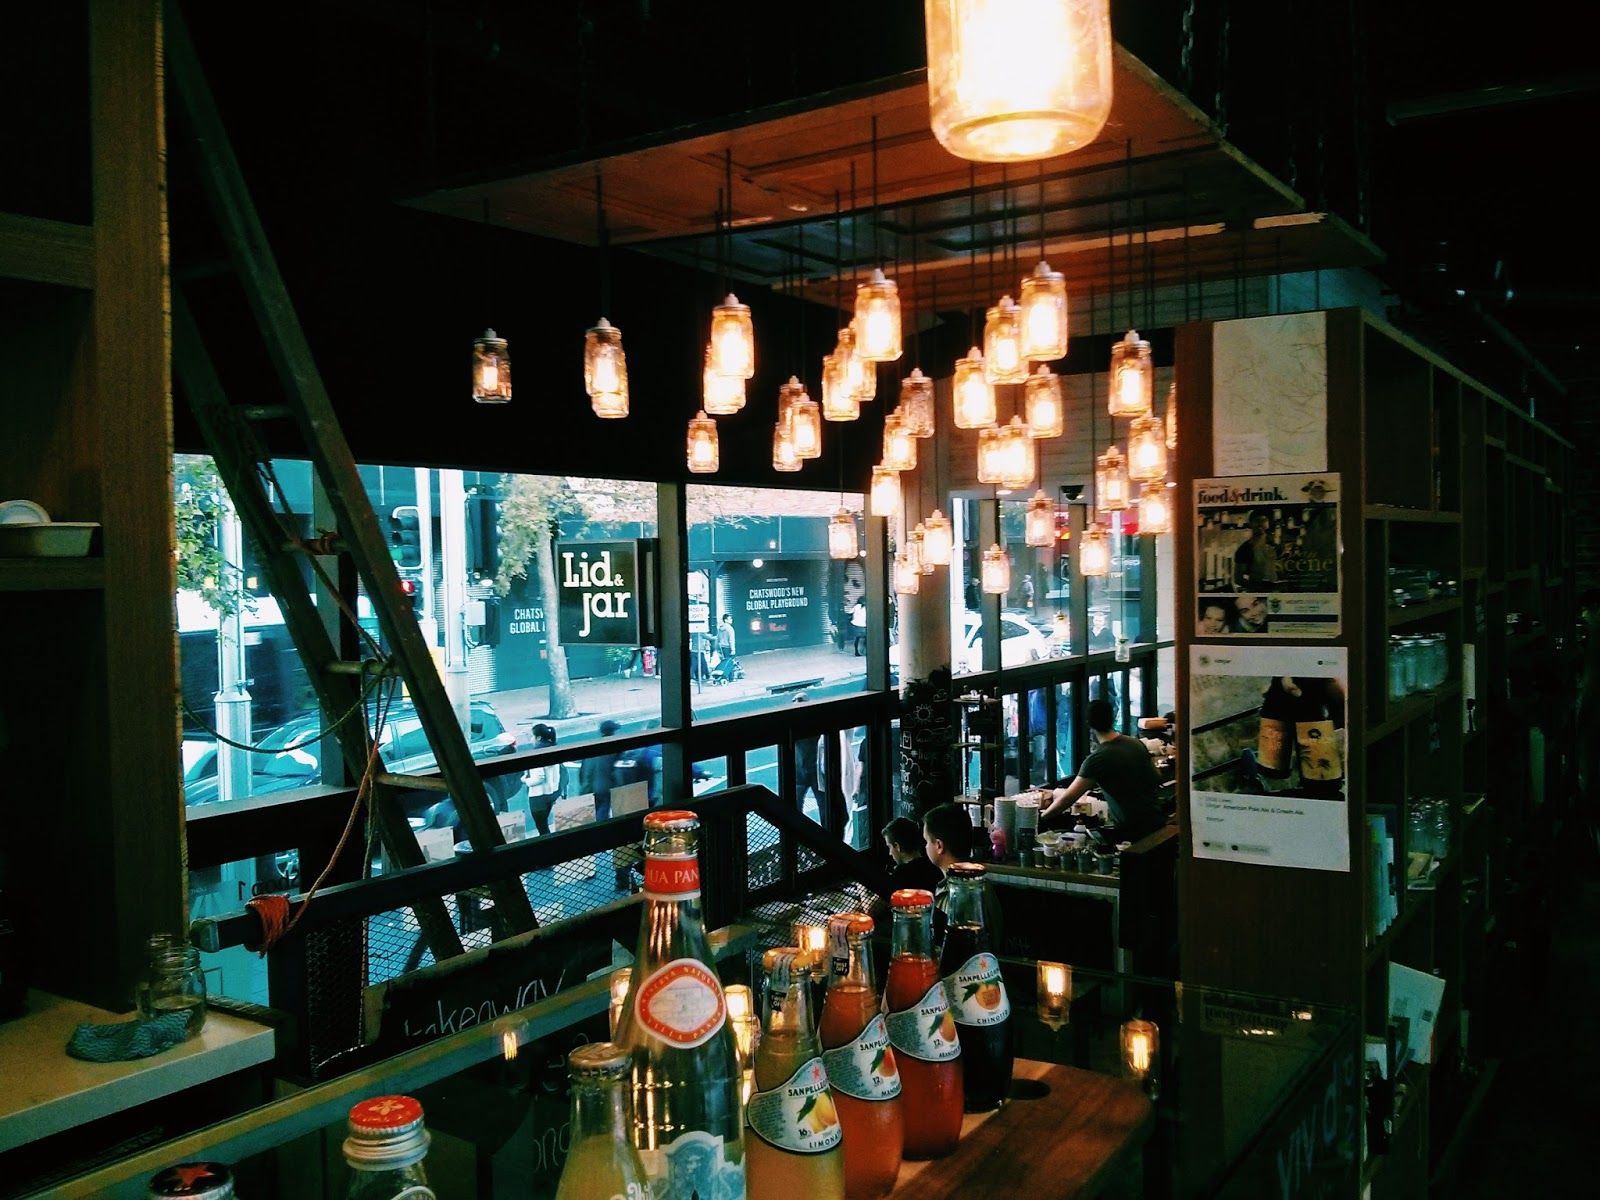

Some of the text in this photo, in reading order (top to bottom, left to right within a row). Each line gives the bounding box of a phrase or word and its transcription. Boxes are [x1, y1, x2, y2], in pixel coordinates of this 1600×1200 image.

[749, 586, 805, 599] CHATSWOOD'S NEW
[746, 597, 808, 611] GLOBAL PLAYGROUND
[578, 591, 631, 637] jar
[509, 621, 541, 634] GLOBAL
